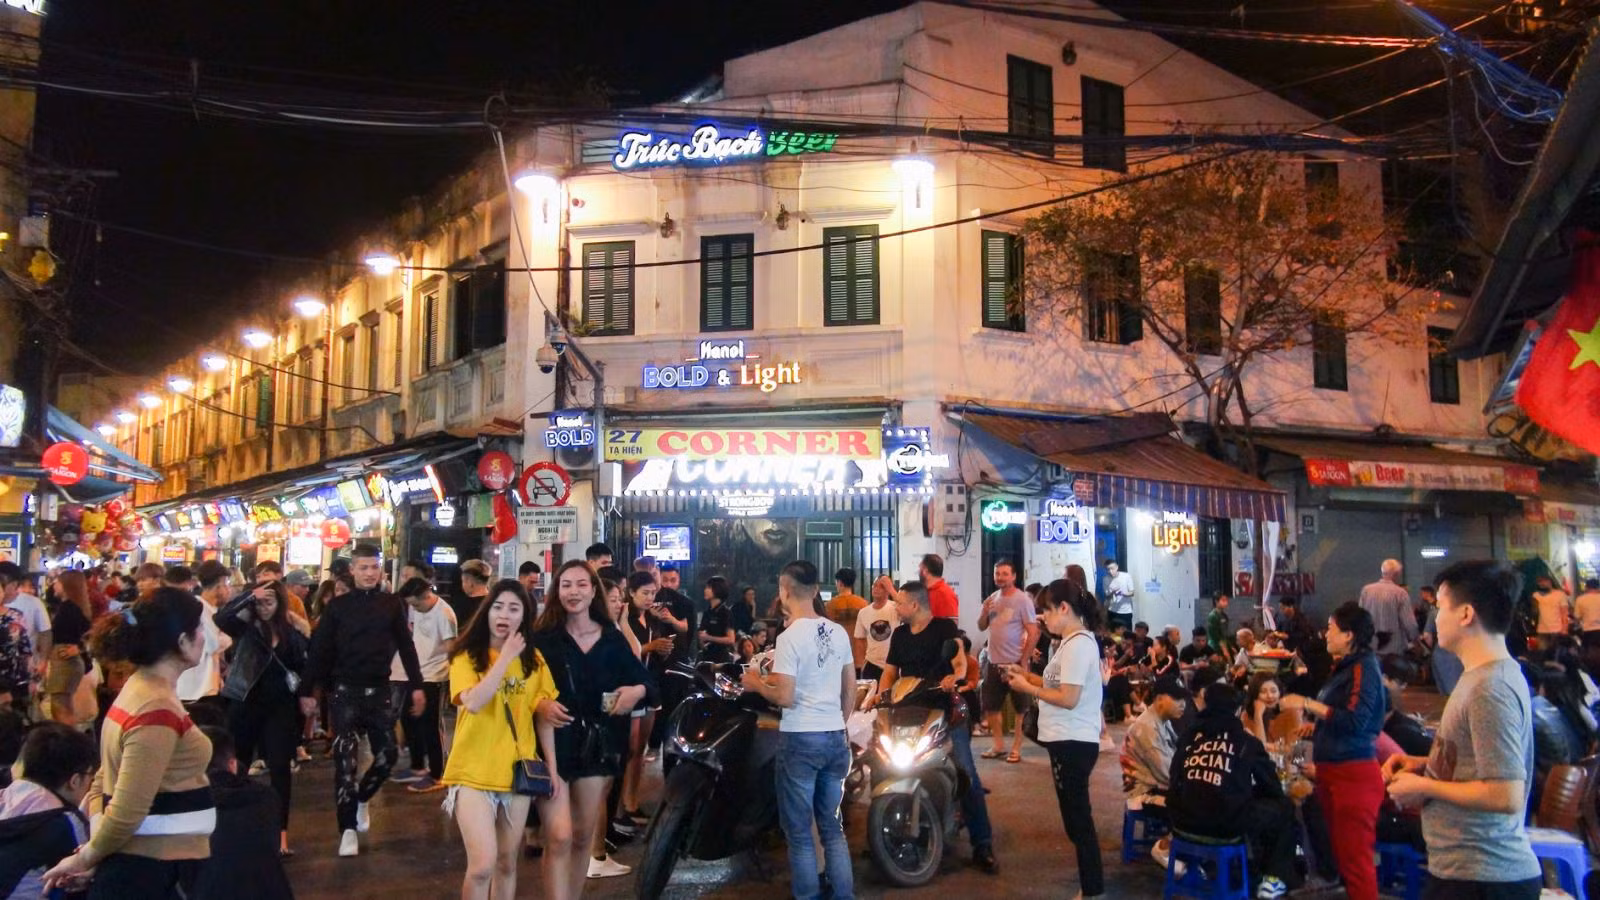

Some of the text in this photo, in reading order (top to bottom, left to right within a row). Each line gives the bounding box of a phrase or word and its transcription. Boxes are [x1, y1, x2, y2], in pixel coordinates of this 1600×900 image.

[615, 133, 681, 167] Trúc
[644, 362, 801, 392] BOLD & Light
[545, 429, 595, 447] BOLD
[608, 430, 872, 456] 27 CORNER
[1375, 463, 1406, 483] Beer
[1040, 519, 1092, 541] BOLD
[1154, 524, 1198, 553] Light
[1187, 769, 1222, 786] CLUB
